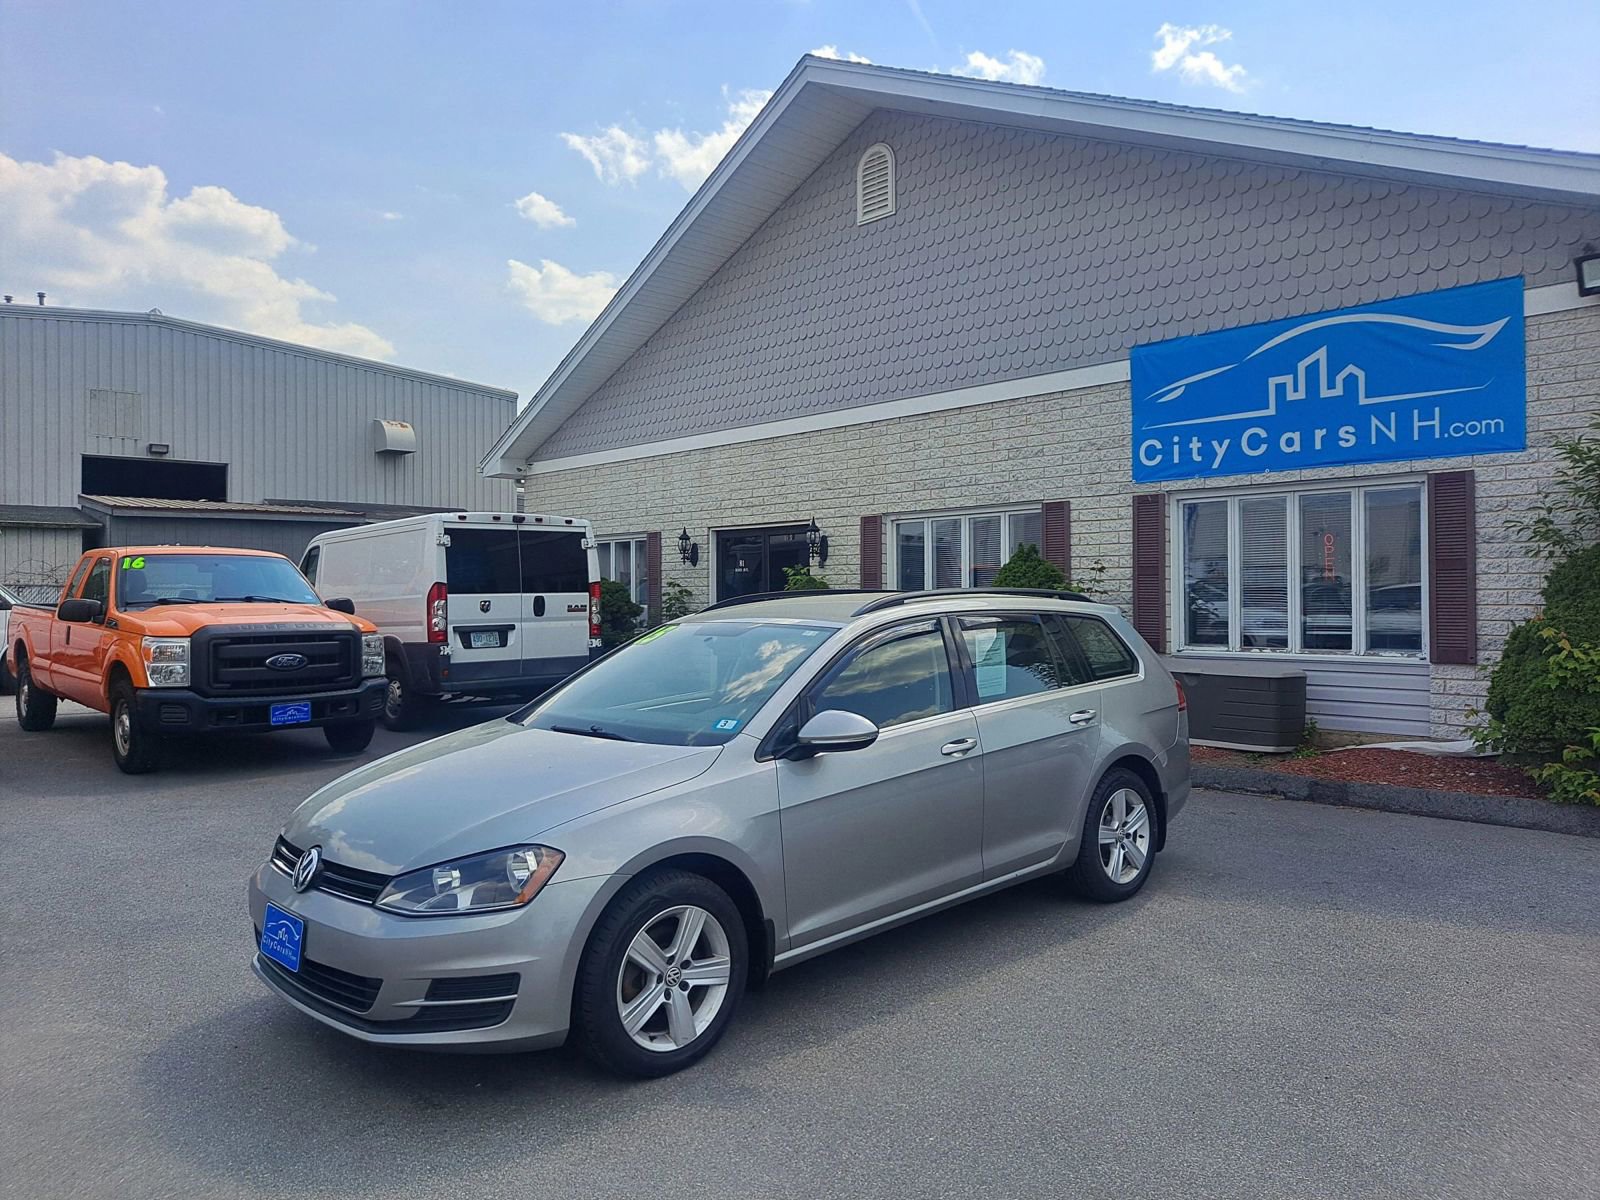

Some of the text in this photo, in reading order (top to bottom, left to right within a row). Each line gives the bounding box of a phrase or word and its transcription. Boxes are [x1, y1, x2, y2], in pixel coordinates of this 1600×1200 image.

[122, 557, 145, 570] 16
[1324, 533, 1335, 584] OPEN
[277, 656, 300, 667] Ford
[720, 720, 729, 728] 3
